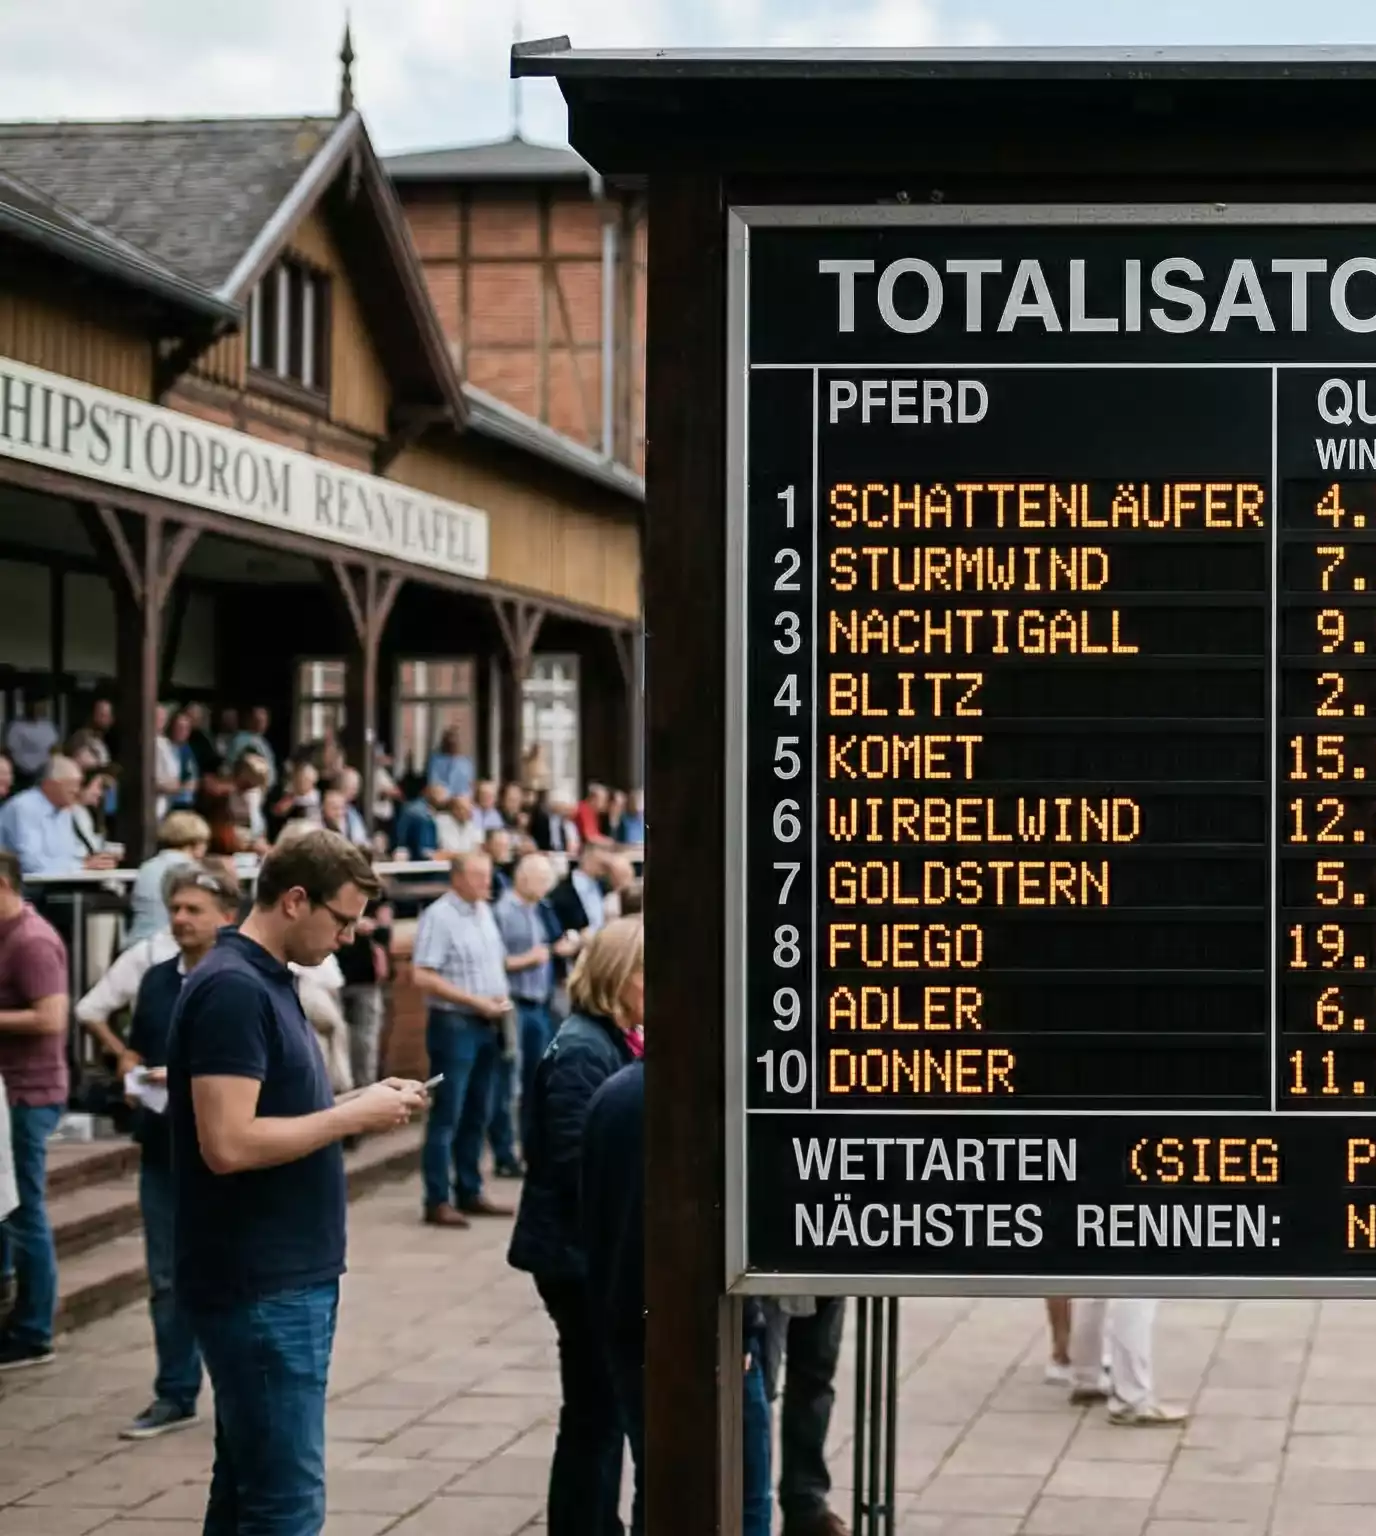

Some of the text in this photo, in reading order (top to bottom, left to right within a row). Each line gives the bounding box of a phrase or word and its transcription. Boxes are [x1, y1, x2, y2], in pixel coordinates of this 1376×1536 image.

[830, 381, 988, 423] PFERD
[314, 473, 477, 565] RENNTAFEL
[778, 485, 794, 527] 1
[831, 484, 1264, 528] SCHATTENLÄUFER
[774, 549, 800, 590] 2
[831, 547, 1108, 591] STURMWIND
[774, 611, 800, 654] 3
[830, 609, 1138, 653] NACHTIGALL
[774, 674, 801, 715] 4
[830, 673, 982, 716] BLITZ
[774, 737, 800, 779] 5
[830, 735, 982, 779] KOMET
[773, 799, 800, 842] 6
[830, 798, 1139, 842] WIRBELWIND
[774, 863, 800, 904] 7
[830, 861, 1108, 905] GOLDSTERN
[773, 925, 800, 967] 8
[830, 924, 982, 968] FUEGO
[773, 988, 800, 1031] 9
[830, 987, 982, 1030] ADLER
[757, 1050, 806, 1093] 10
[830, 1049, 1014, 1093] DONNER
[793, 1138, 1076, 1181] WETTARTEN
[1132, 1138, 1277, 1182] (SIEG
[796, 1194, 1280, 1247] NÄCHSTES RENNEN:
